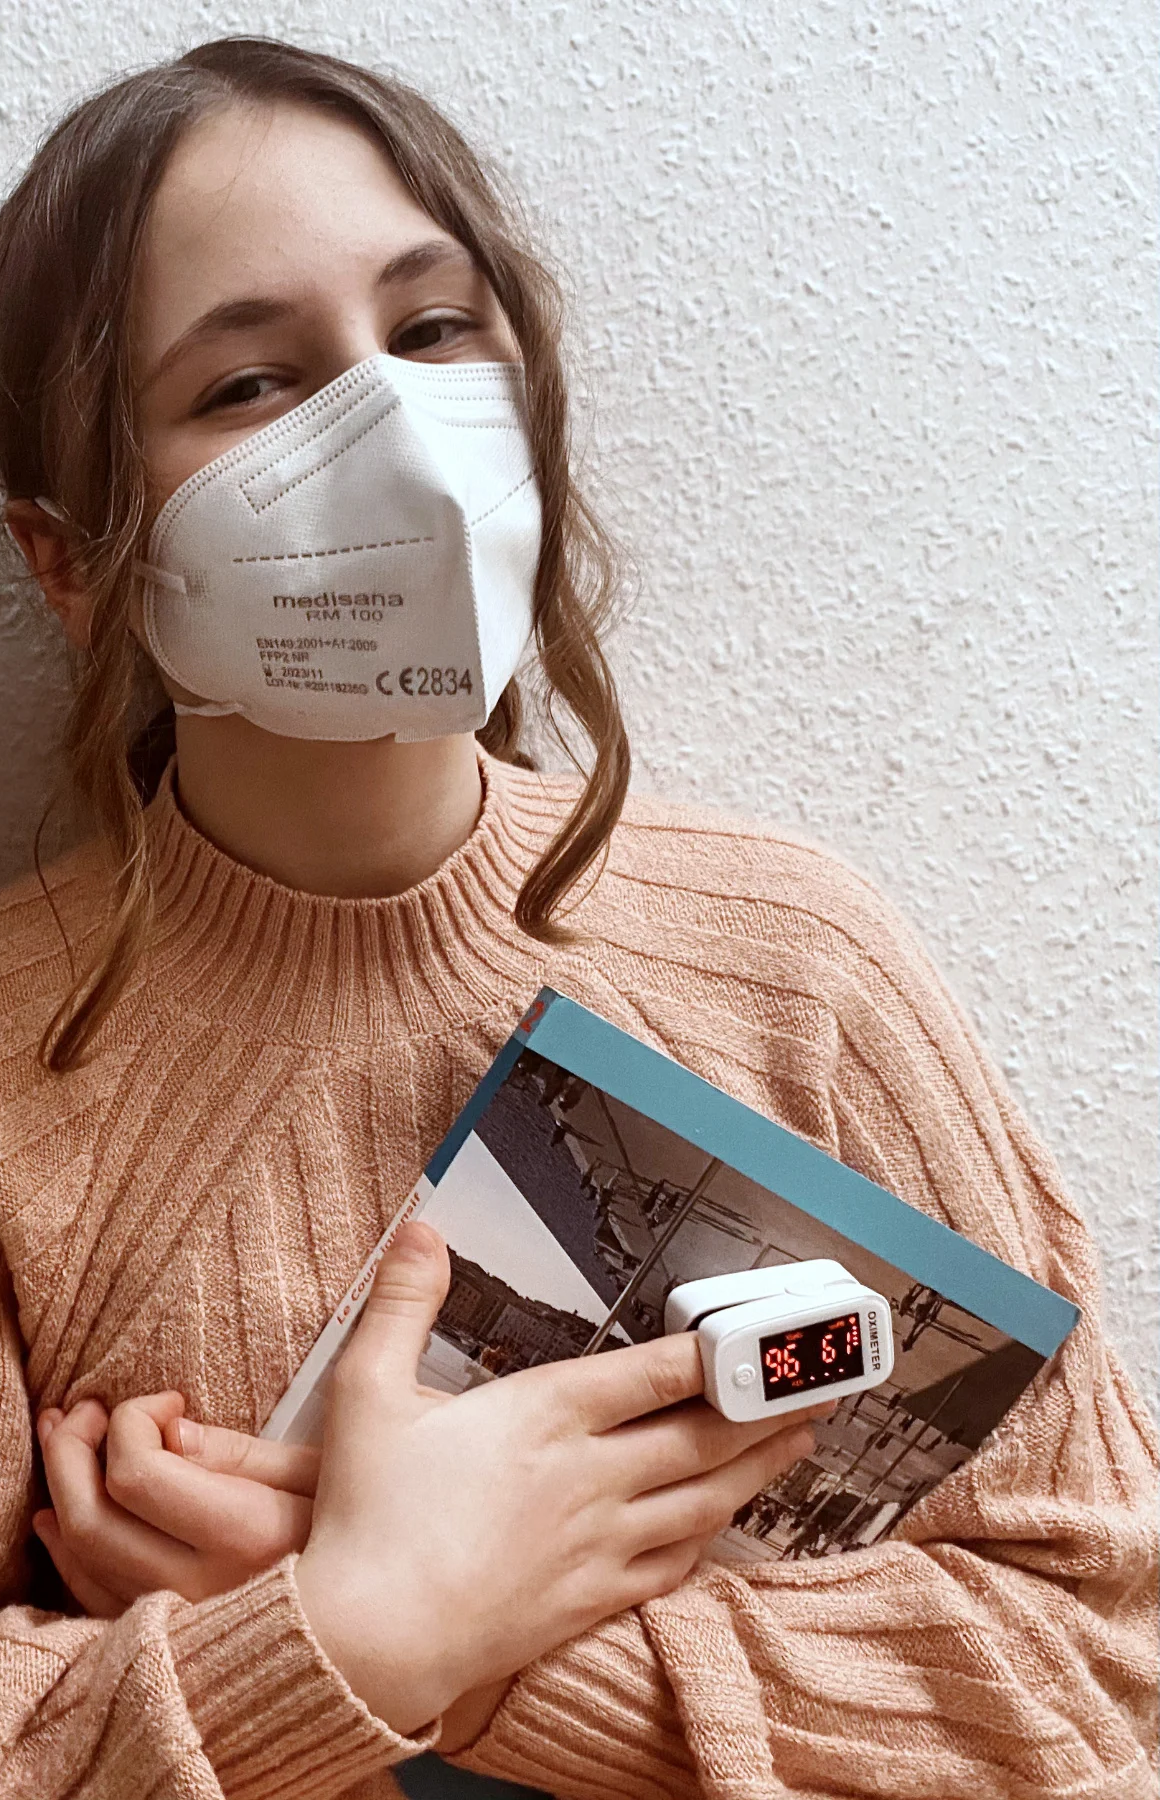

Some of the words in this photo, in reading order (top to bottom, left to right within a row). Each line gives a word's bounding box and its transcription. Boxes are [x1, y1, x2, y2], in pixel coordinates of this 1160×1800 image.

[273, 591, 404, 608] medisana
[306, 609, 341, 622] RM
[351, 608, 384, 622] 100
[259, 650, 290, 664] FFP2
[416, 666, 473, 696] 2834
[520, 1000, 545, 1034] 2
[337, 1305, 351, 1325] Le
[867, 1311, 881, 1371] OXIMETER
